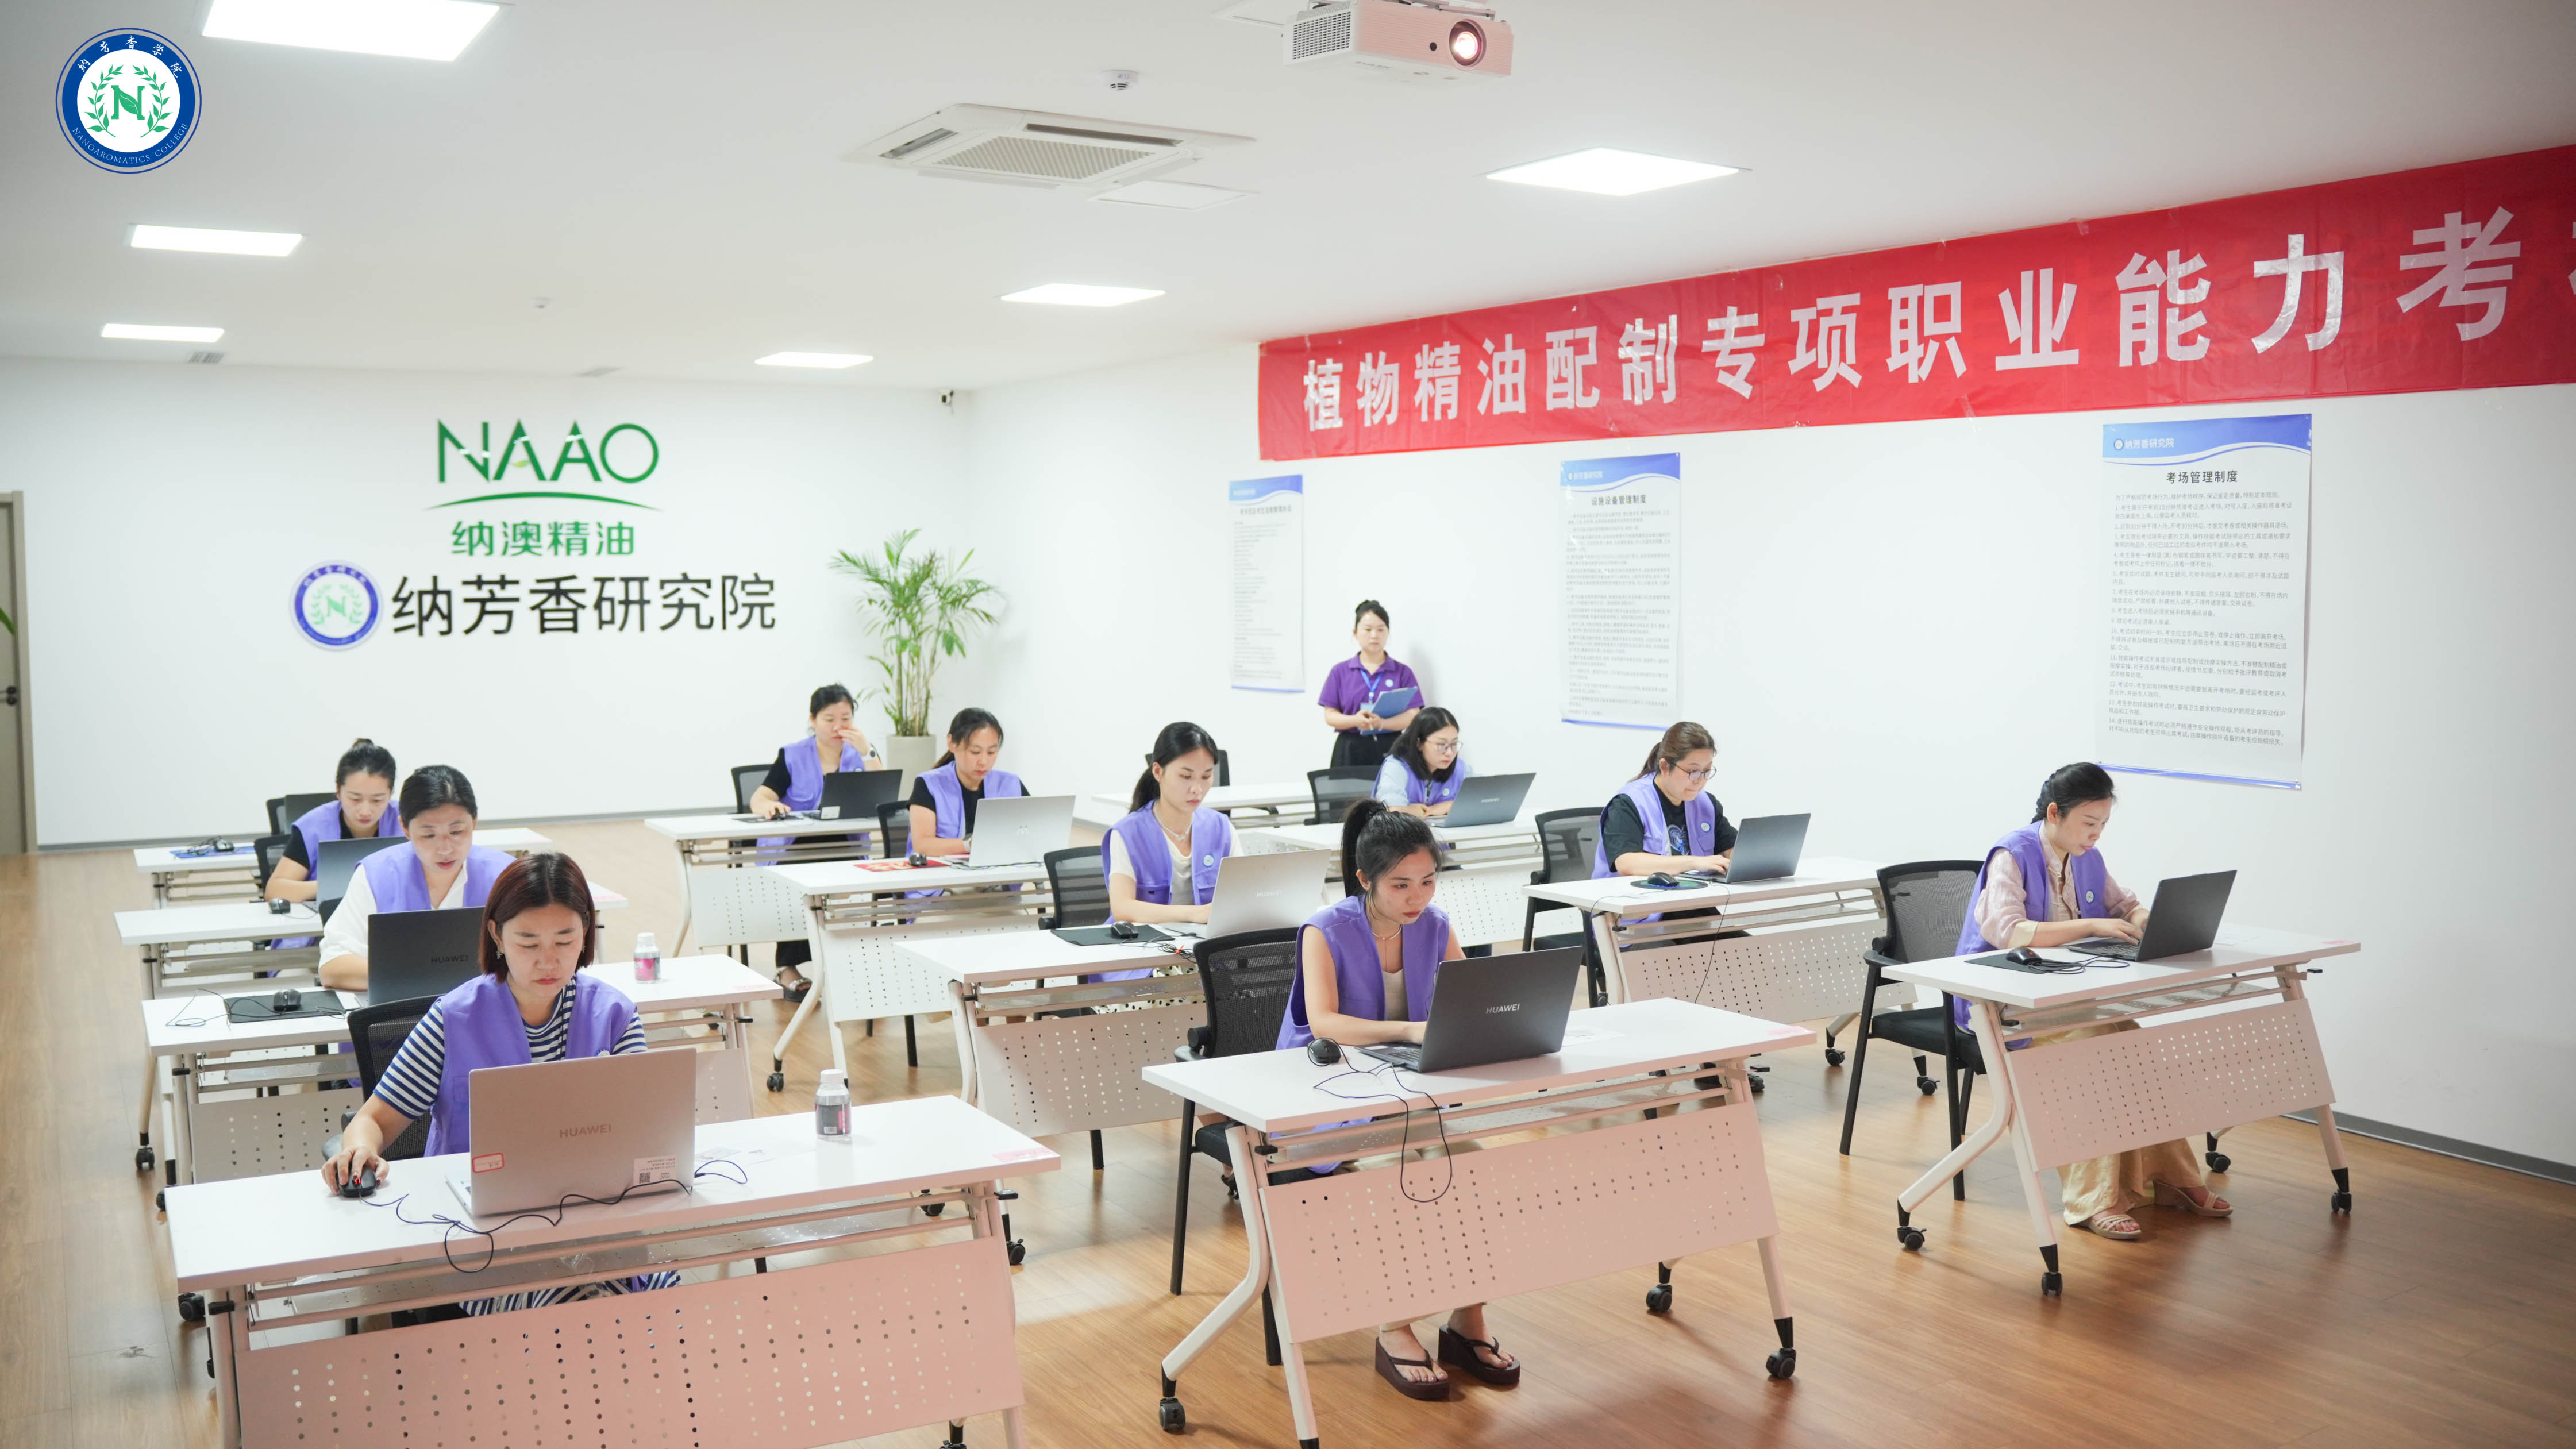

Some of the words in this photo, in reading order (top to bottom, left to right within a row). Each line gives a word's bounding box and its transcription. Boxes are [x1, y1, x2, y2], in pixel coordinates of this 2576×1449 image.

[1303, 206, 2576, 431] 植物精油配制专项职业能力考
[437, 419, 660, 483] NAAO
[2124, 438, 2175, 449] 纳芳香研究院
[2166, 470, 2239, 484] 考场管理制度
[451, 520, 635, 557] 纳澳精油
[391, 572, 776, 638] 纳芳香研究院
[430, 955, 469, 964] HUAWEI
[1485, 1003, 1520, 1014] HUAWEI
[559, 1123, 612, 1138] HUAWEI
